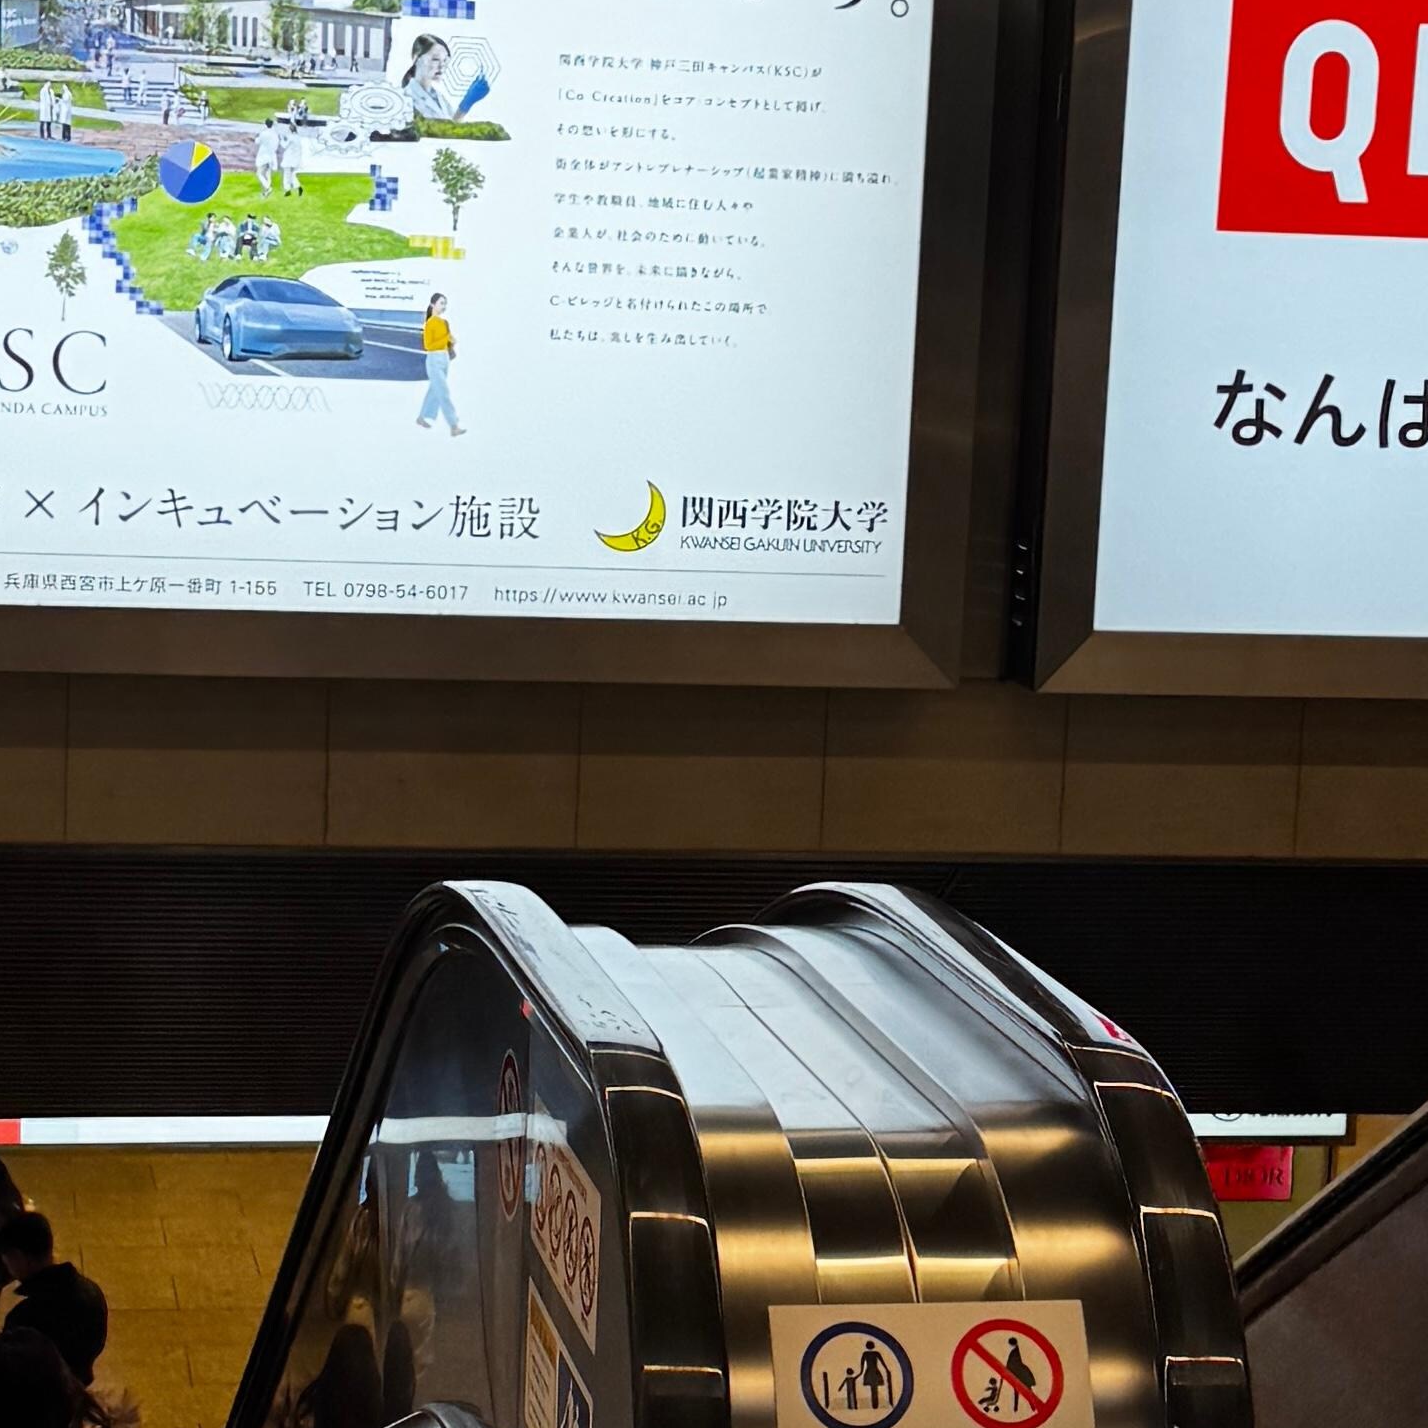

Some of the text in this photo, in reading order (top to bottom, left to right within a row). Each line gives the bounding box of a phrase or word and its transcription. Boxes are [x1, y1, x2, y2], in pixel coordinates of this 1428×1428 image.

[41, 403, 108, 417] CAMPUS
[78, 486, 540, 540] インキュベーション施設
[681, 496, 888, 533] 関西学院大学
[680, 535, 882, 554] KWANSEI GAKUIN UNIVERSITY
[231, 580, 277, 596] 1-155
[304, 582, 336, 598] TEL
[344, 582, 469, 601] 0798-54-6017
